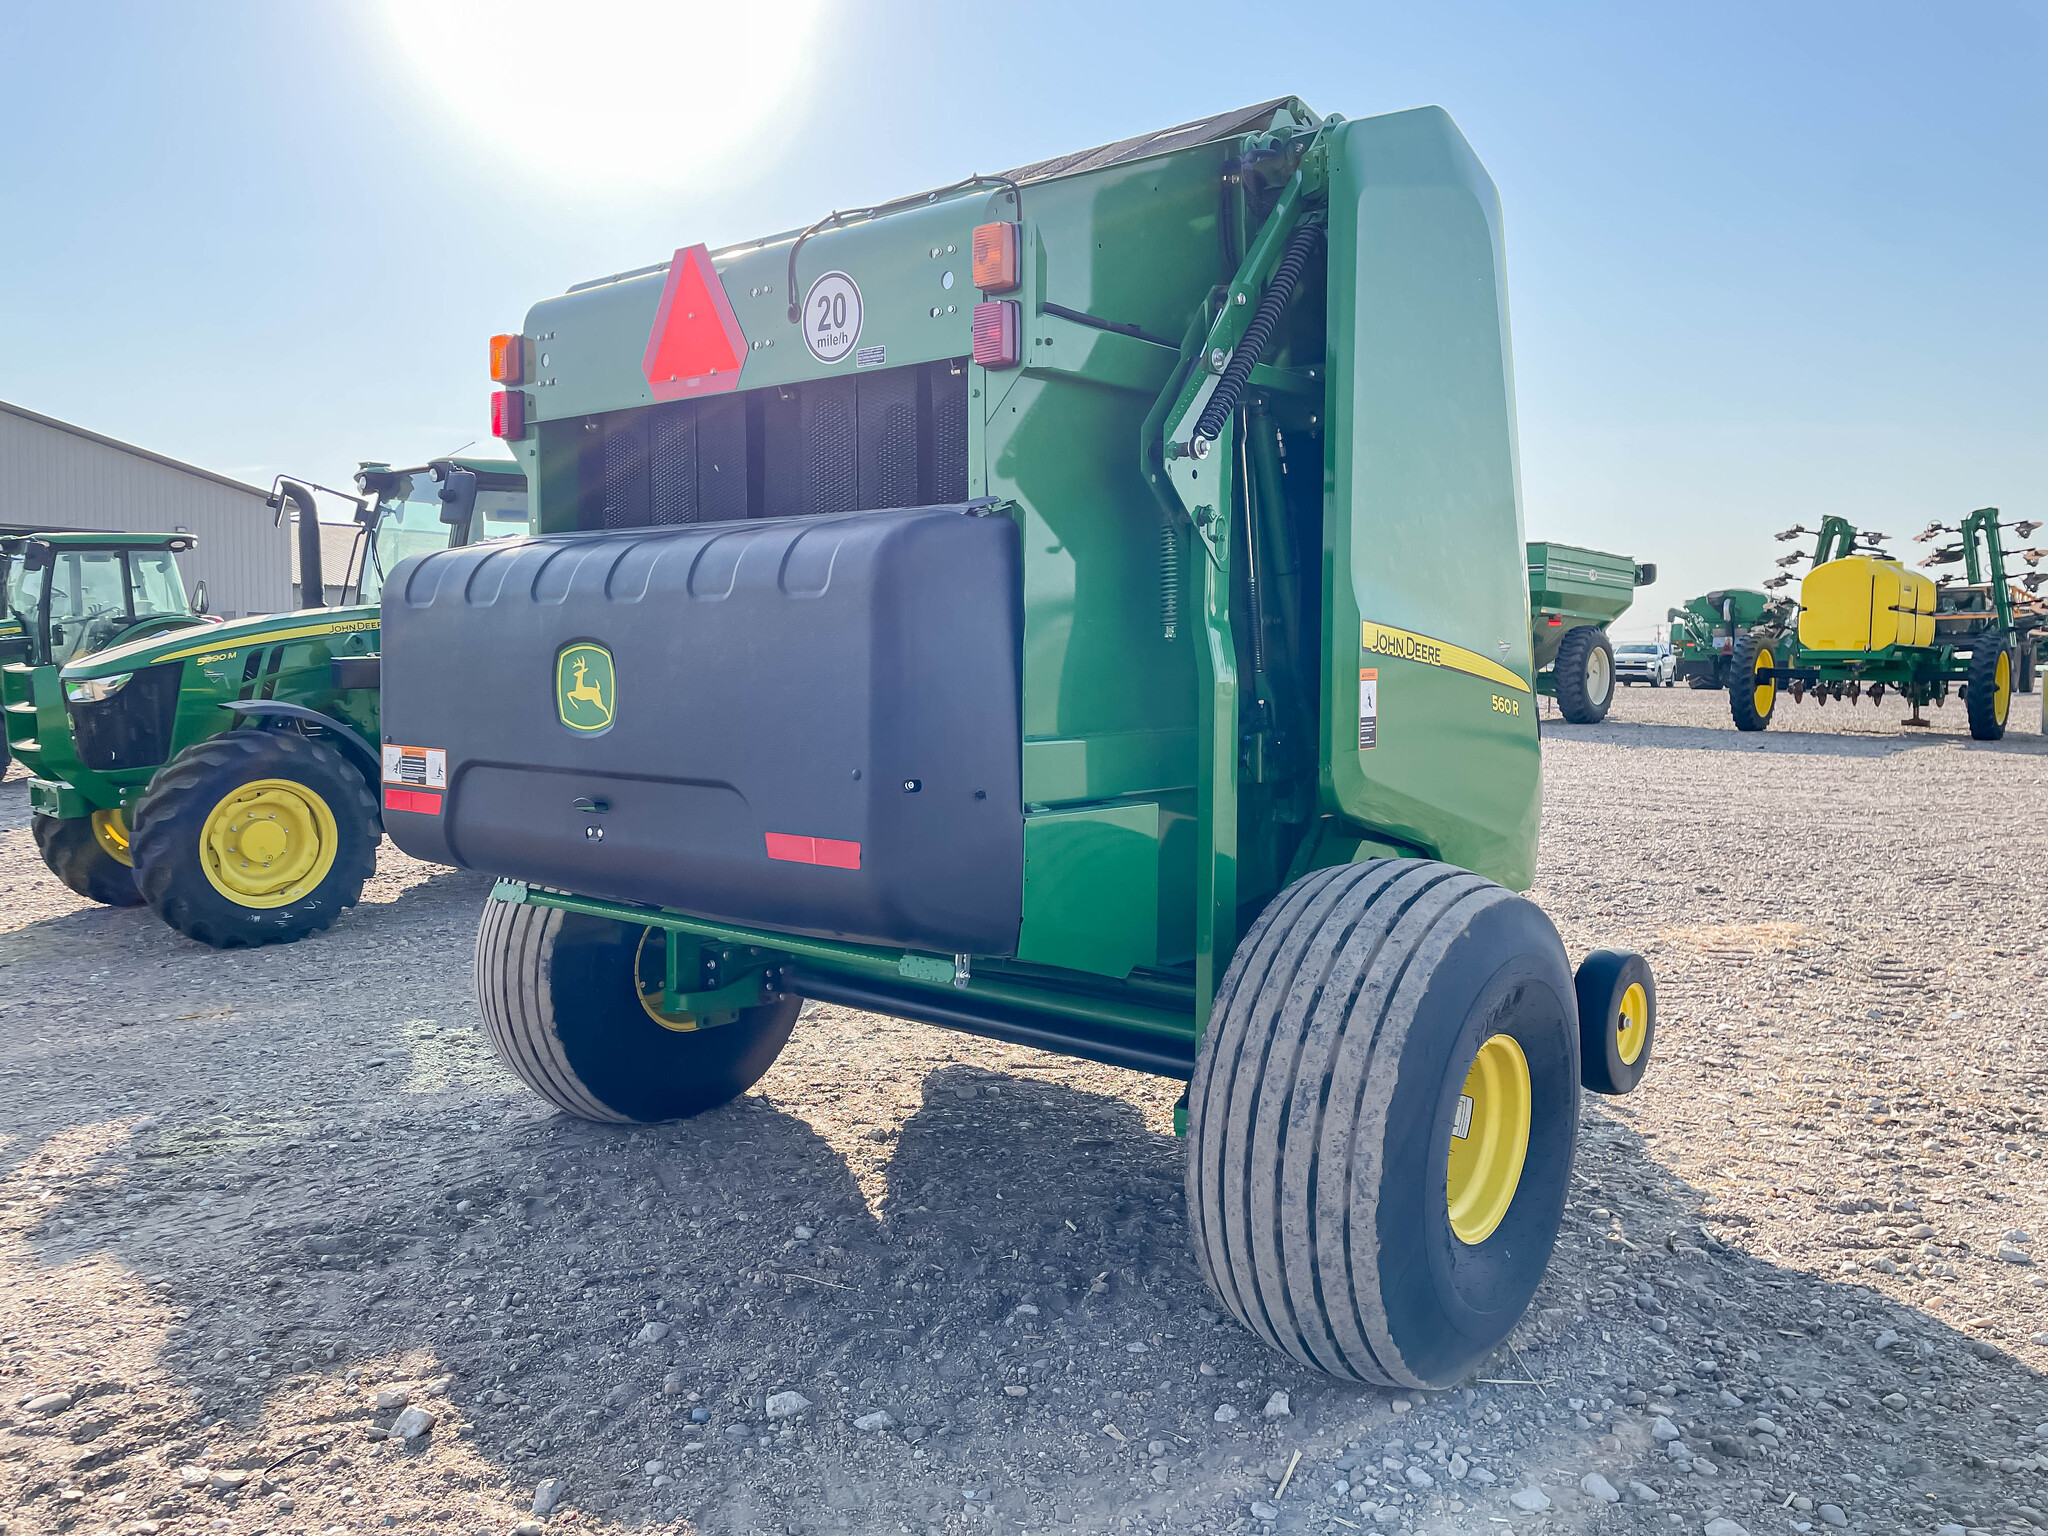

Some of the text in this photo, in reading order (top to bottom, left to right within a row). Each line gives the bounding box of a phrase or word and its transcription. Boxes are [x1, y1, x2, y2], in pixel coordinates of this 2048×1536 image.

[817, 292, 847, 332] 20
[817, 331, 849, 348] mile/h
[329, 624, 356, 633] JOHN
[227, 651, 238, 660] M
[1372, 629, 1441, 664] JOHN DEERE
[1491, 693, 1520, 717] 560 R
